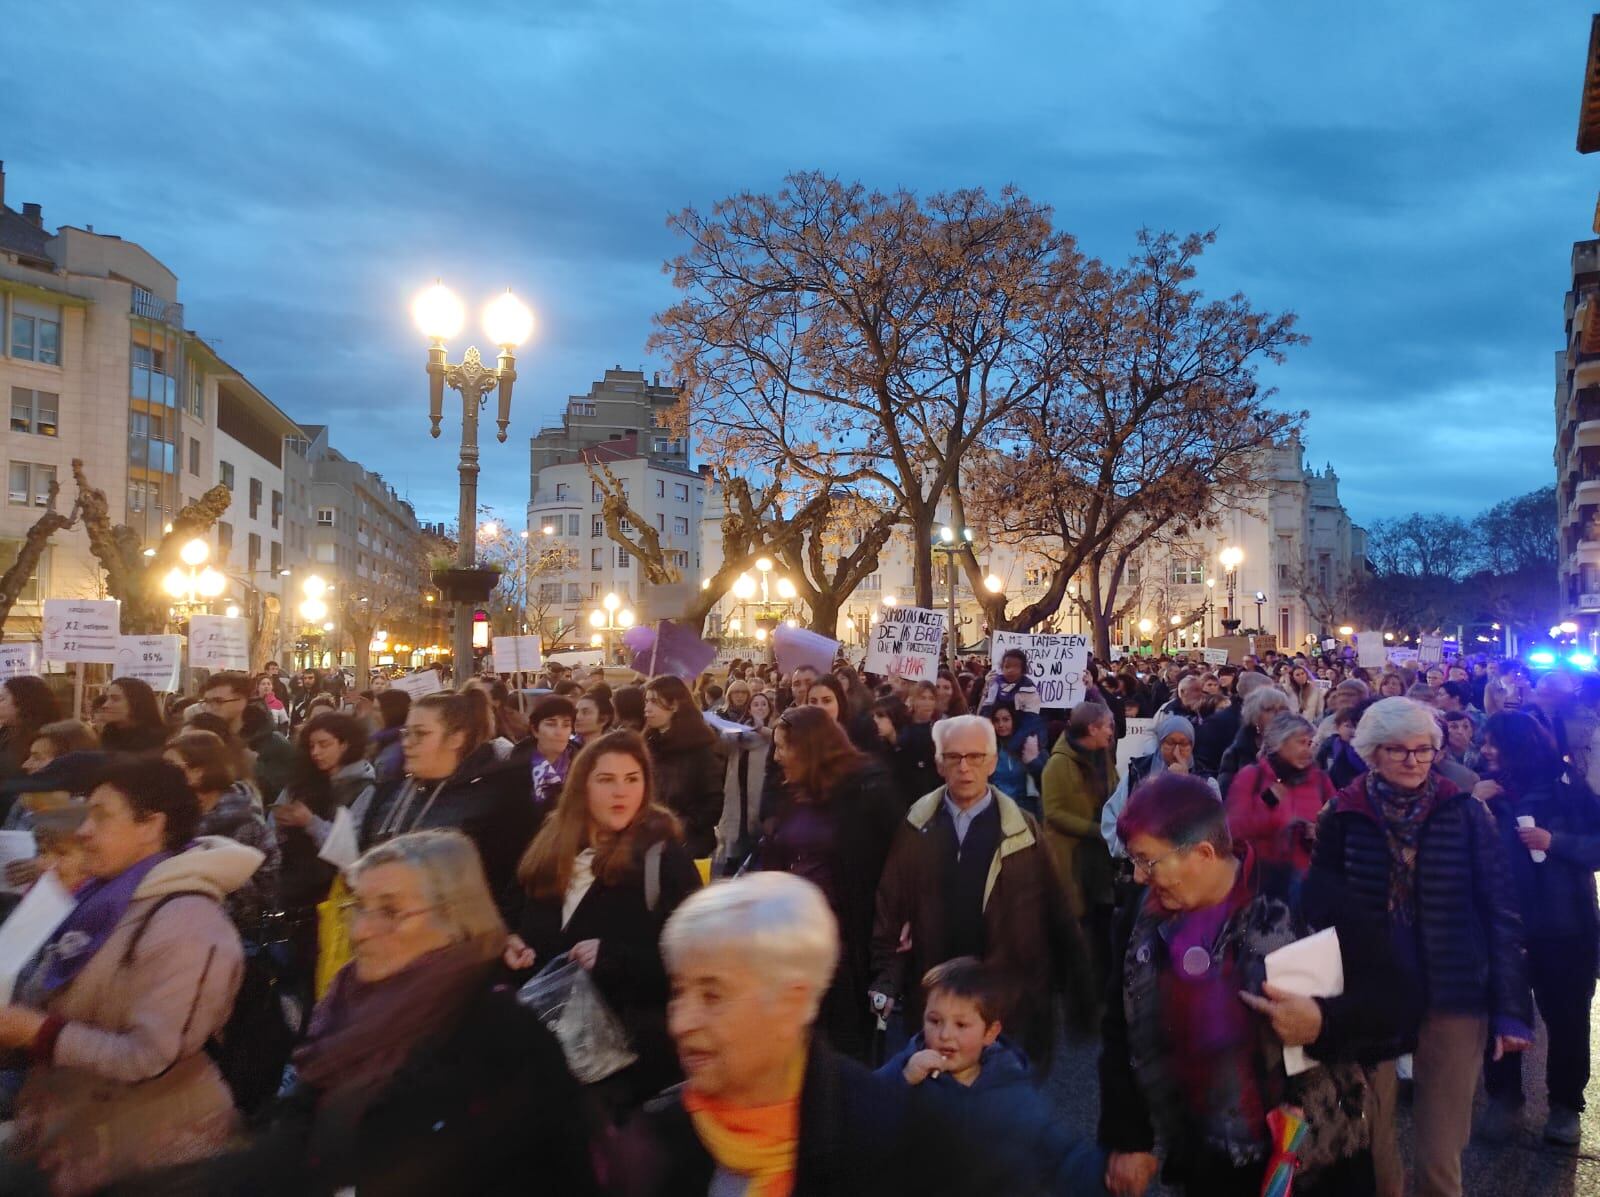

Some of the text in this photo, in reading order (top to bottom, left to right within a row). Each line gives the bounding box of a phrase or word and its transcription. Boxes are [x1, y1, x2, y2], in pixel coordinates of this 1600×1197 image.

[880, 606, 907, 624] SOMOS
[877, 624, 898, 640] DE
[997, 633, 1005, 644] A
[877, 640, 892, 654] QUE
[892, 640, 903, 655] NO
[1054, 647, 1074, 661] LAS
[1050, 661, 1063, 676] NO
